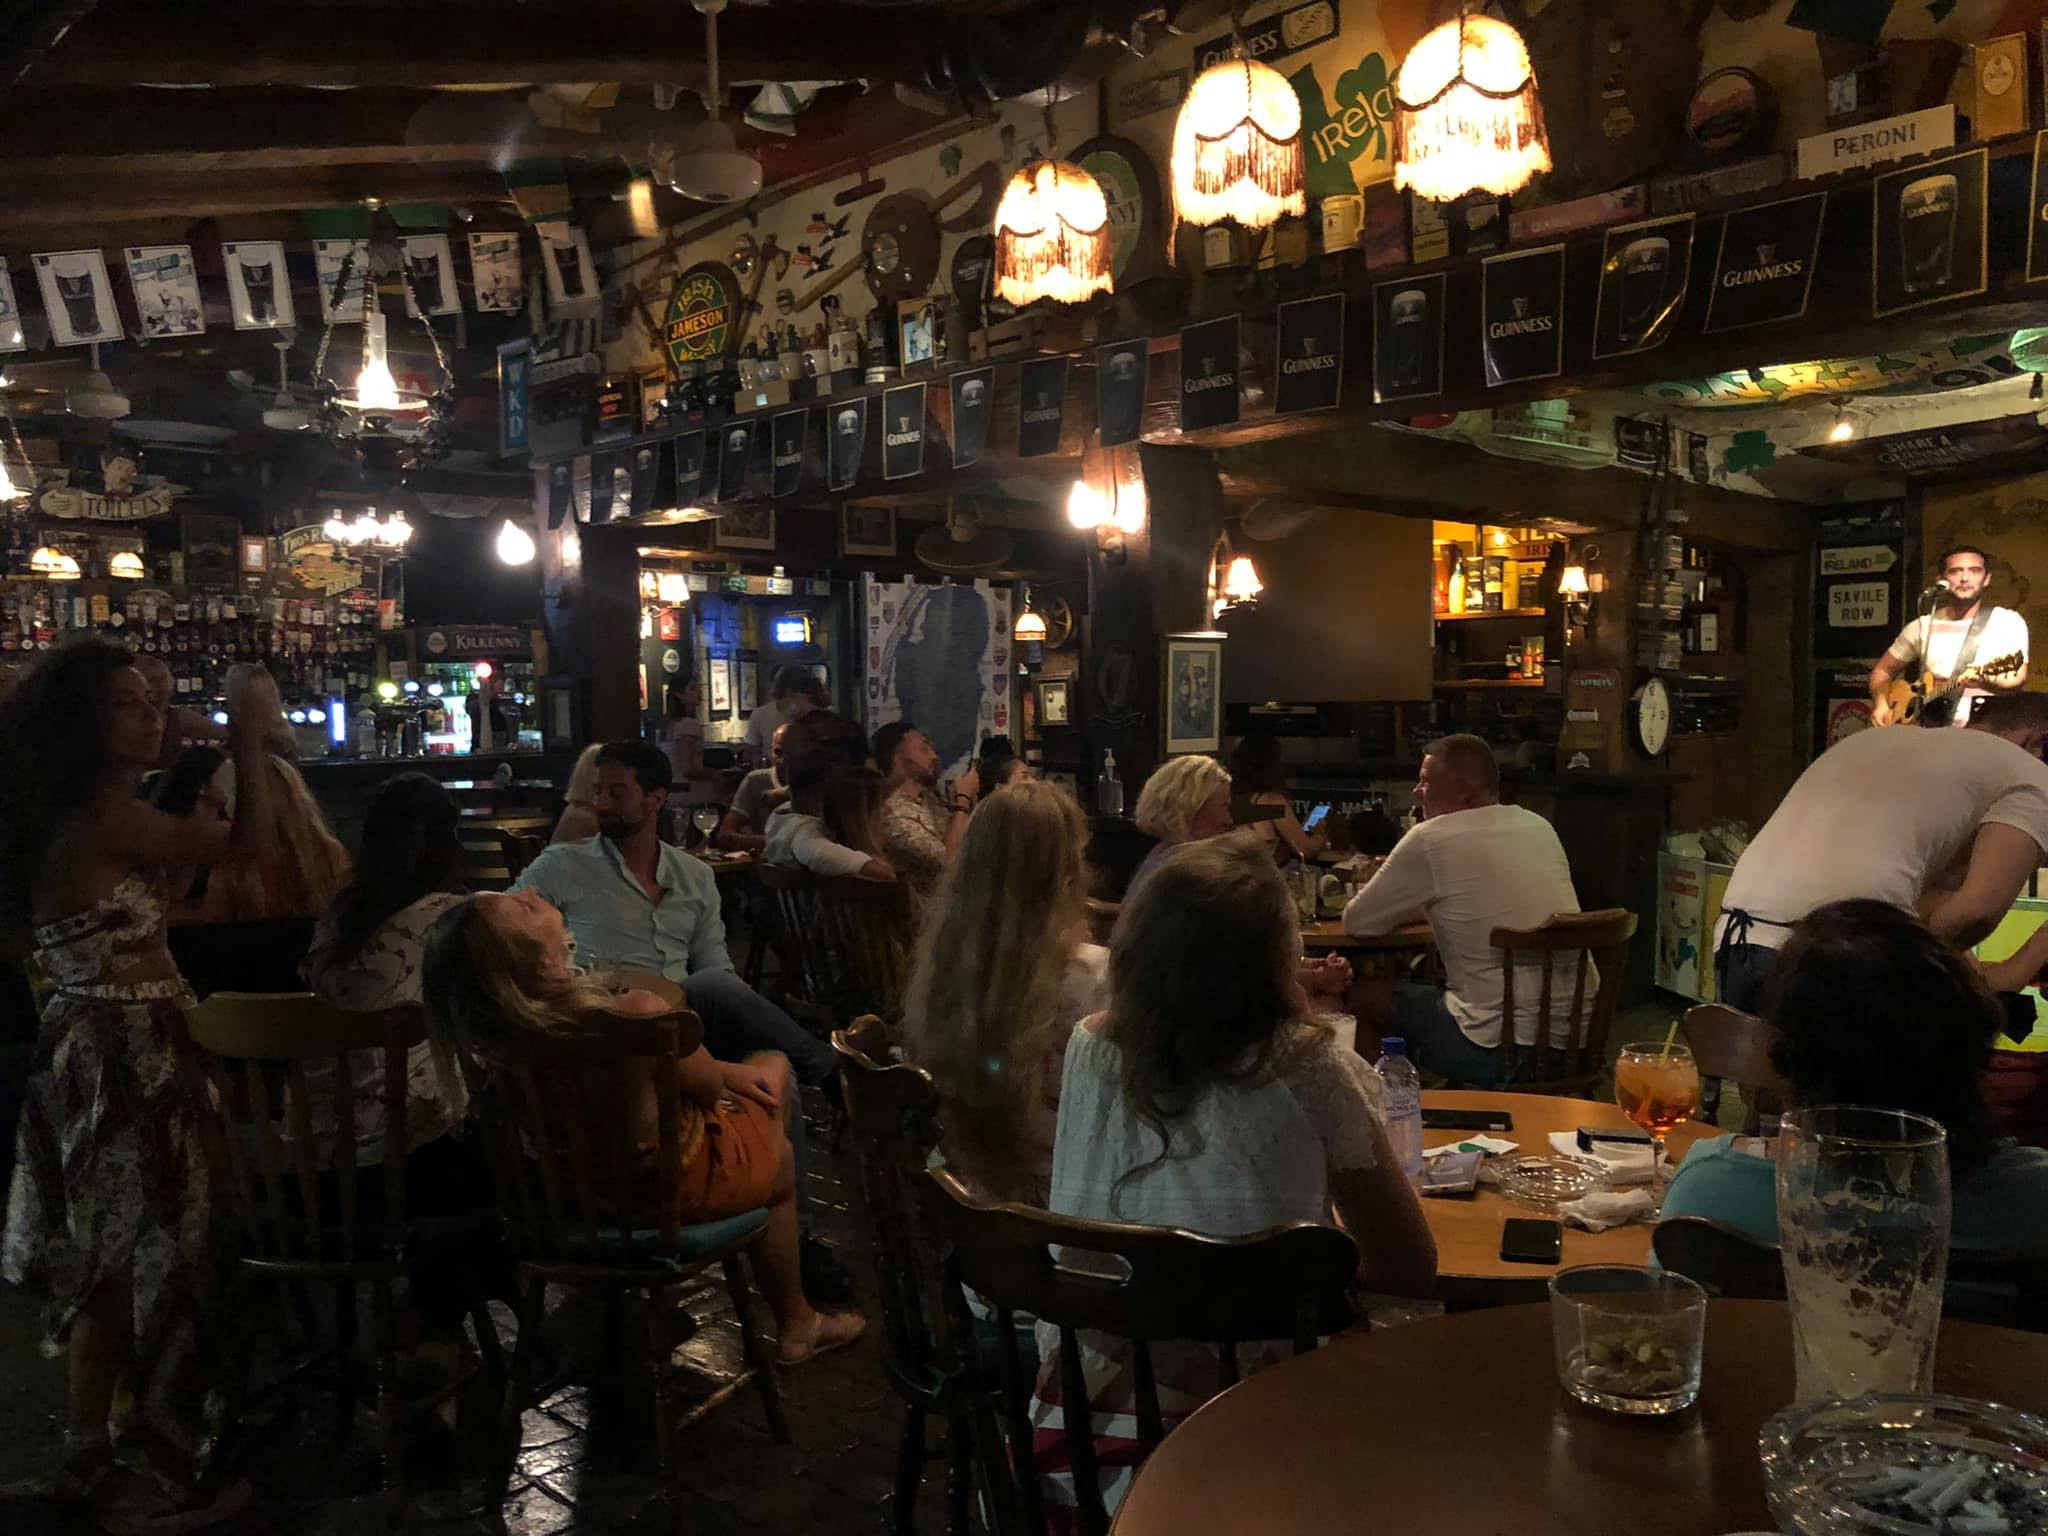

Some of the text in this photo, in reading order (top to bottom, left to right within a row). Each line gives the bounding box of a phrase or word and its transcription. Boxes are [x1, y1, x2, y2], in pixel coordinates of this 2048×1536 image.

[1833, 123, 1916, 157] PERONI
[1722, 259, 1804, 288] GUINNESS
[671, 310, 724, 339] JAMESON
[1489, 315, 1553, 340] GUINNESS
[1283, 353, 1337, 375] GUINNESS
[1184, 373, 1233, 395] GUINNESS
[87, 496, 162, 518] TOILETS
[1833, 589, 1885, 604] SAVILE
[1841, 607, 1875, 621] ROW
[455, 634, 521, 650] KILKENNY
